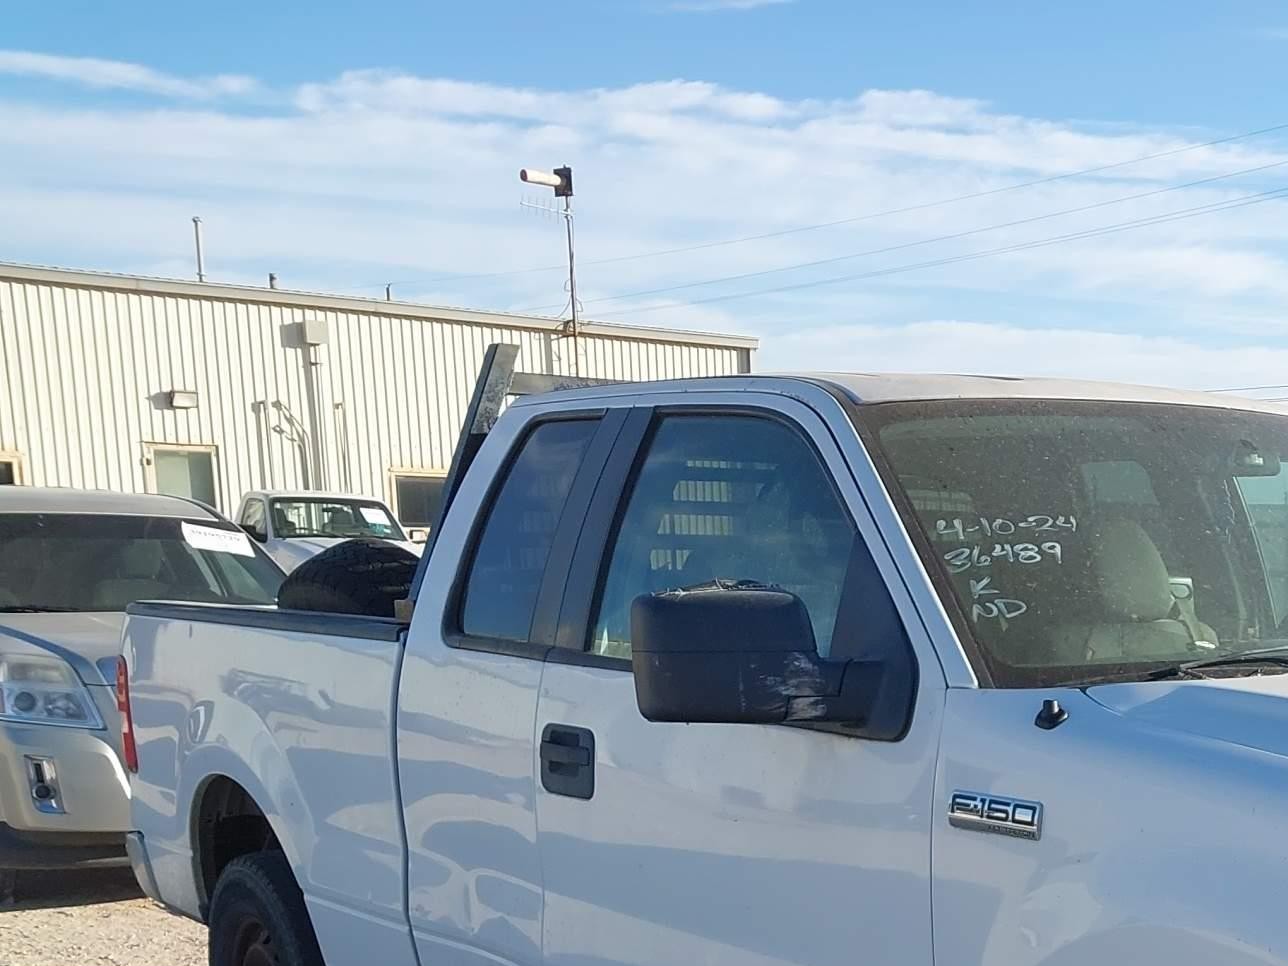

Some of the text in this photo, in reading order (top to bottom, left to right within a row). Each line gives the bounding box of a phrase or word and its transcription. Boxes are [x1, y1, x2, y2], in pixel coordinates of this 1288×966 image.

[936, 514, 1077, 539] 4-10-24
[944, 541, 1062, 573] 36489
[969, 576, 1000, 599] K
